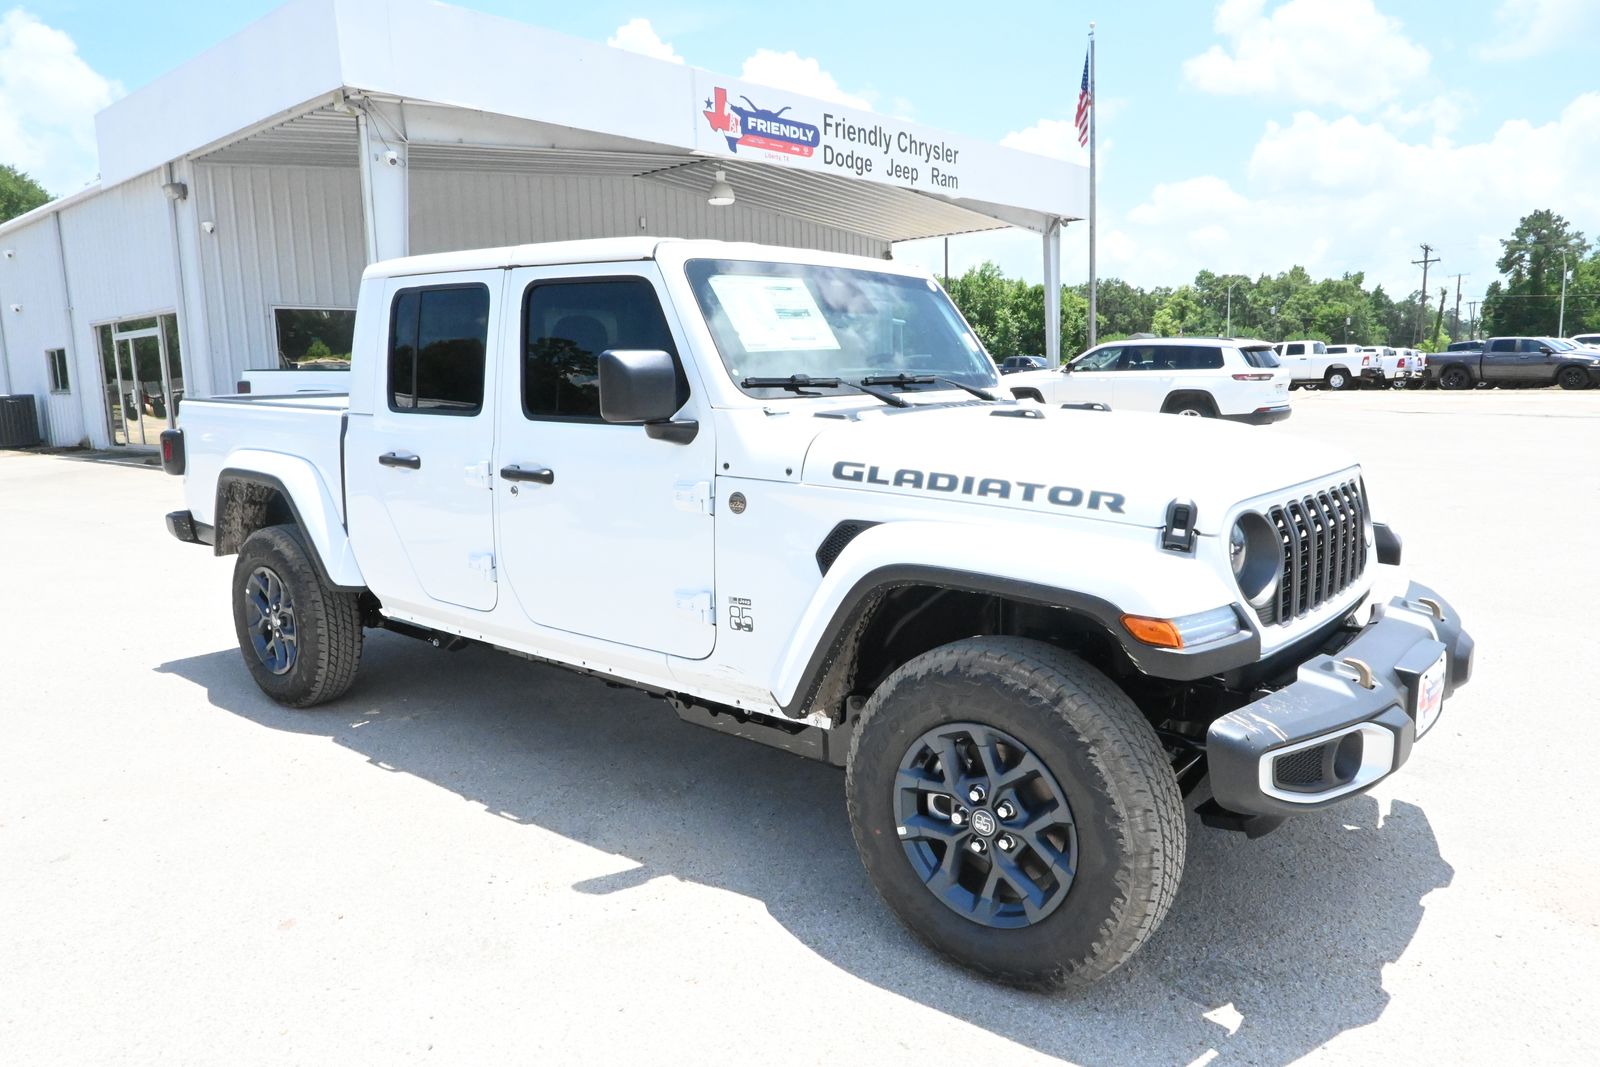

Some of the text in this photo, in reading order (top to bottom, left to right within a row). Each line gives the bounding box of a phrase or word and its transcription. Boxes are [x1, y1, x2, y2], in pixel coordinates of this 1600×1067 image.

[747, 116, 815, 142] FRIENDLY
[823, 112, 959, 164] Friendly Chrysler
[823, 144, 959, 189] Dodge Jeep Ram
[832, 460, 1126, 514] GLADIATOR
